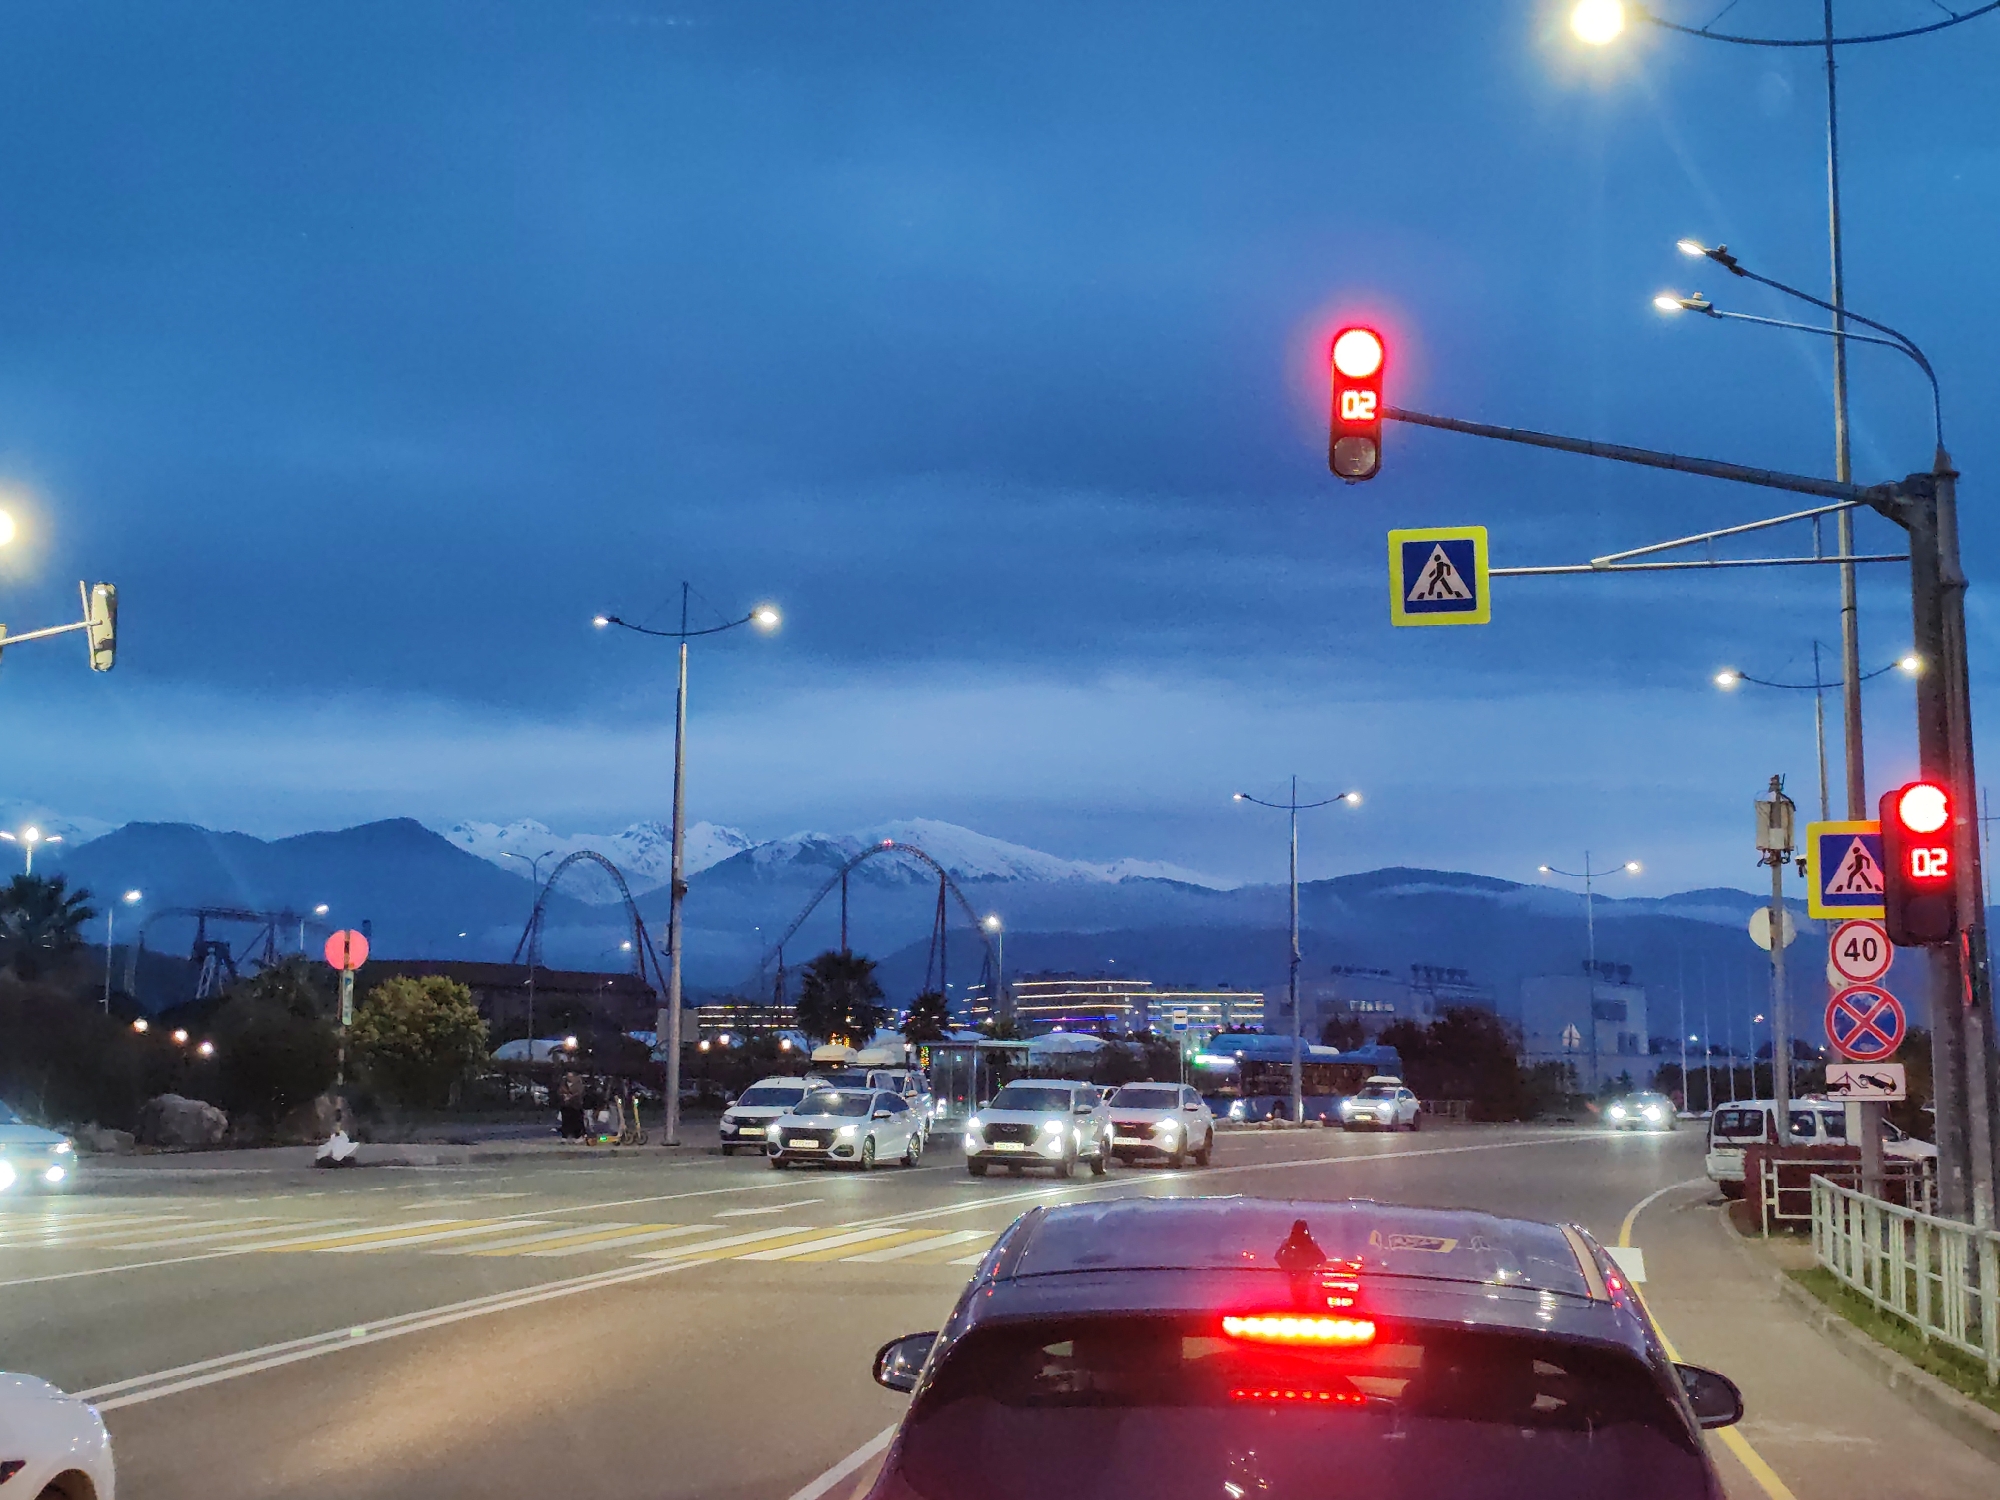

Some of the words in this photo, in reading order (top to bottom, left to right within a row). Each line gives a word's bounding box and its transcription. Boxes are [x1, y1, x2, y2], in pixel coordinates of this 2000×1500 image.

[1341, 390, 1377, 420] 02
[1911, 847, 1948, 877] 02
[1843, 937, 1878, 962] 40
